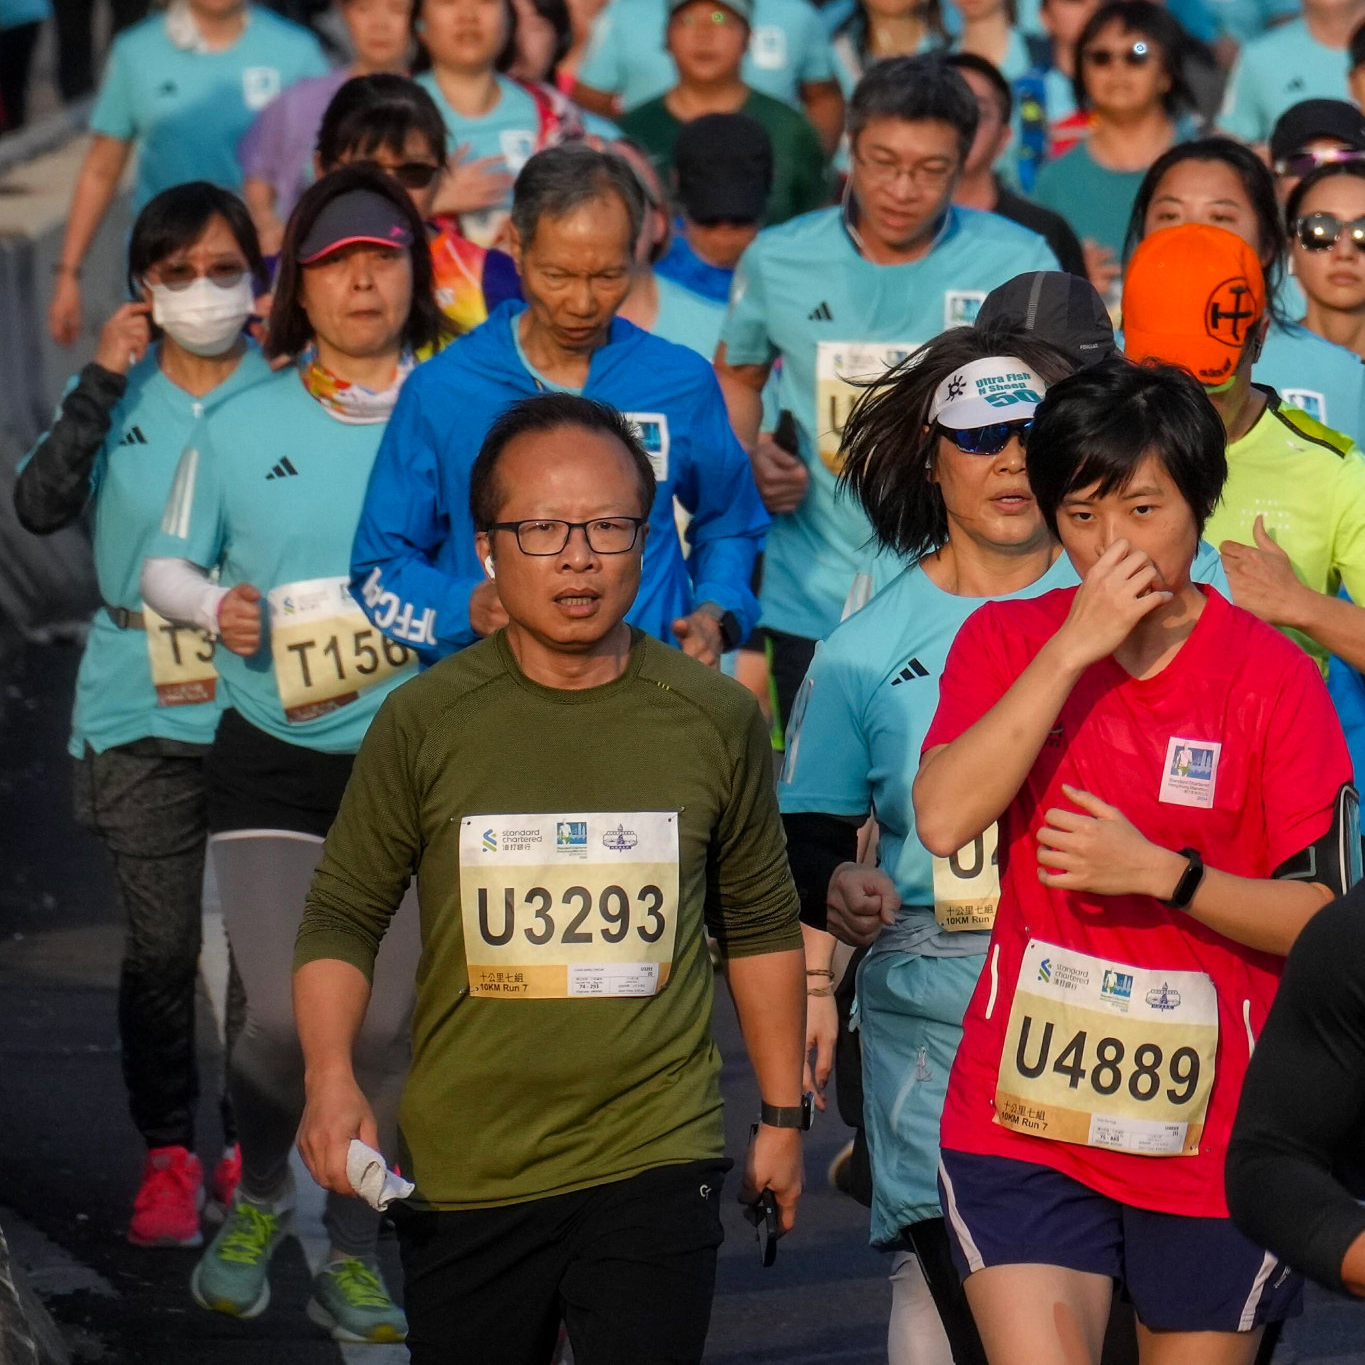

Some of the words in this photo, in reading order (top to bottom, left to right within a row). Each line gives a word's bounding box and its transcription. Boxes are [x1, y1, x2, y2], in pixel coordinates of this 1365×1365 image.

[975, 375, 1005, 388] Ultra
[1006, 372, 1031, 382] Fish
[988, 382, 1027, 392] Sheep
[984, 389, 1043, 407] 50
[287, 630, 409, 688] T156
[949, 833, 998, 879] U
[478, 885, 665, 946] U3293
[946, 904, 994, 916] 十公里七組
[946, 916, 968, 925] 10KM
[972, 915, 989, 923] Run
[480, 972, 524, 983] 十公里七組
[1055, 970, 1090, 986] chartered
[1056, 962, 1089, 978] standard
[480, 983, 501, 992] 10KM
[503, 984, 520, 992] Run
[523, 984, 528, 992] 7
[1016, 1016, 1201, 1105] U4889
[1003, 1101, 1046, 1121] 十公里七組
[1001, 1111, 1020, 1125] 10KM
[1021, 1117, 1040, 1130] Run
[1042, 1121, 1048, 1131] 7
